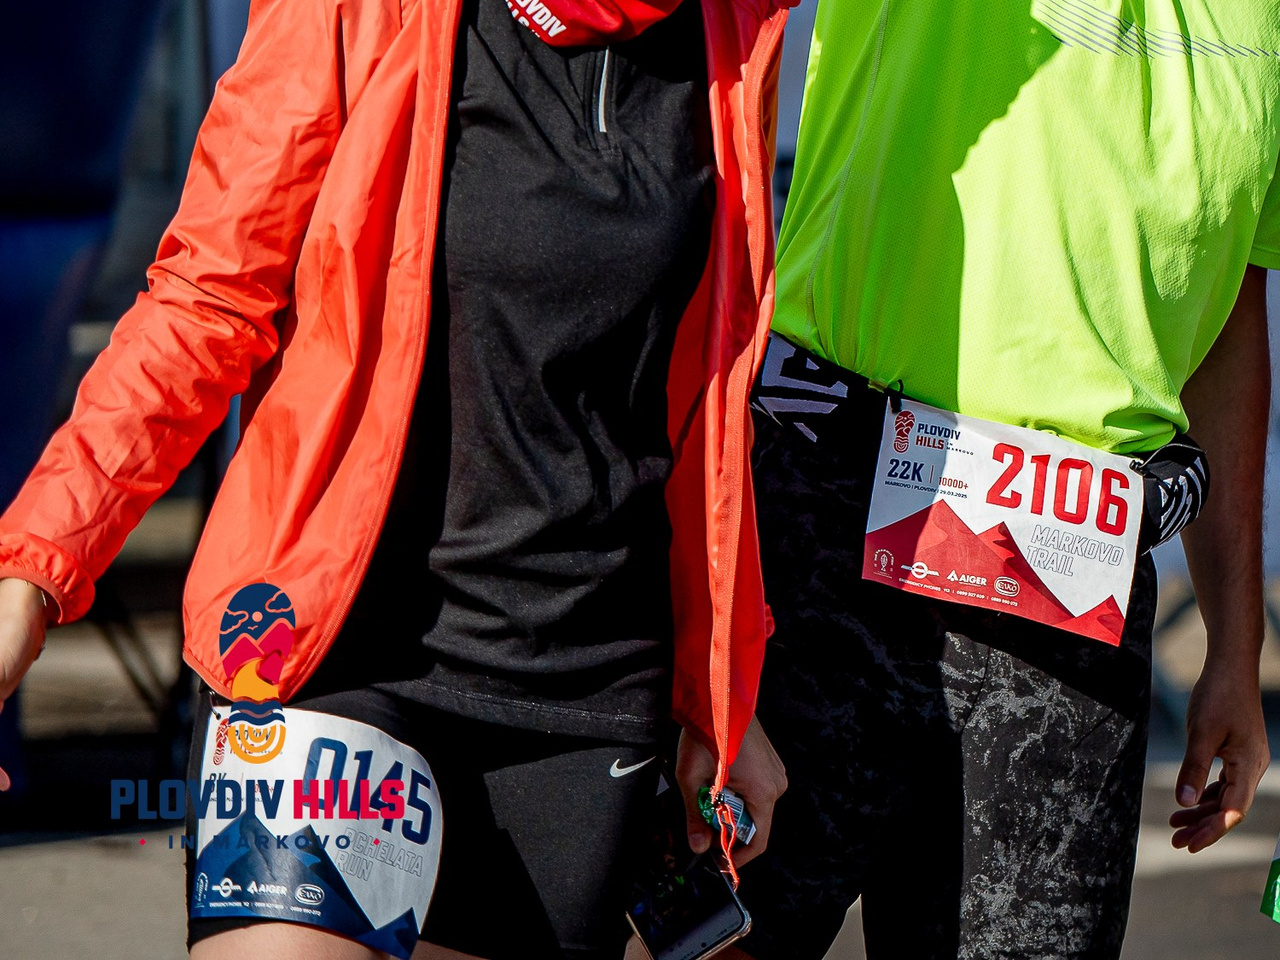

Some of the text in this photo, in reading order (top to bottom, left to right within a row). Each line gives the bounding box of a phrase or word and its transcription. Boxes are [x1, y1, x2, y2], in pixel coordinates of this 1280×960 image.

[915, 435, 945, 450] HILLS
[917, 423, 961, 440] PLOVDIV
[887, 458, 925, 482] 22K
[986, 442, 1130, 536] 2106
[1026, 545, 1075, 577] TRAIL
[1030, 524, 1125, 567] MARKOVO
[959, 574, 987, 586] AIGER
[302, 737, 432, 845] 0145
[335, 850, 374, 882] RUN
[344, 827, 424, 877] PCHELATA
[258, 883, 288, 896] AIGER
